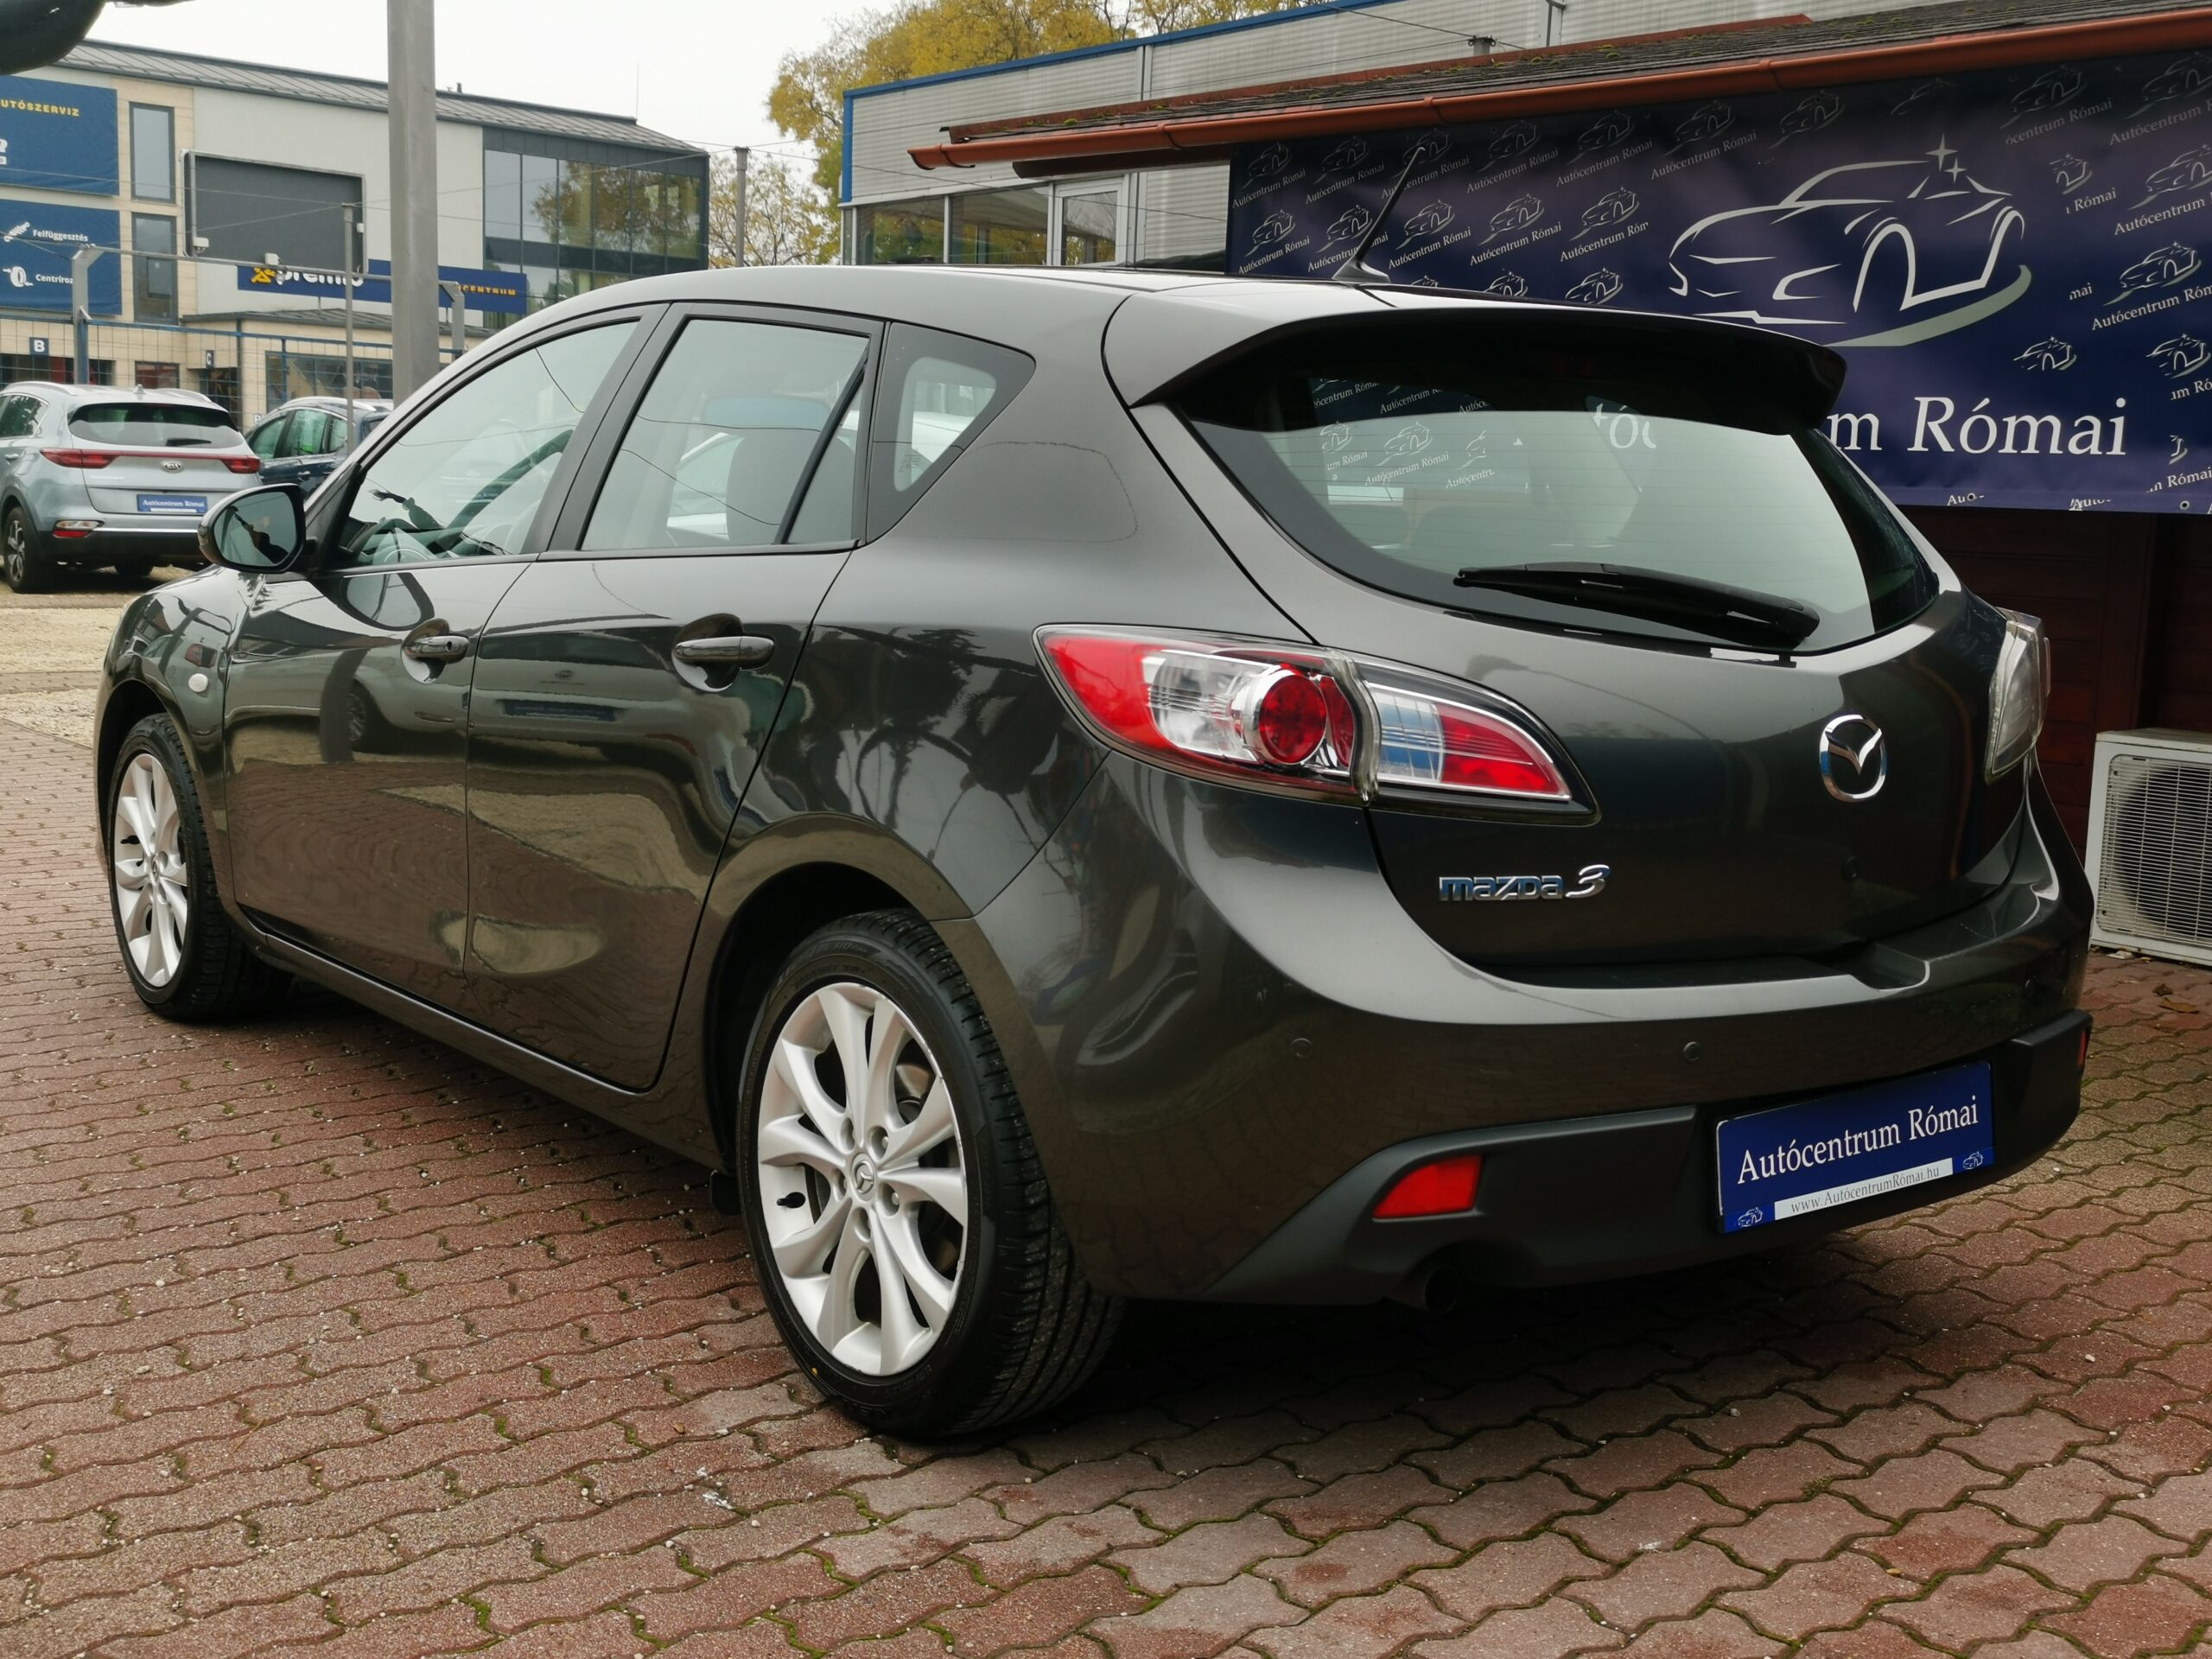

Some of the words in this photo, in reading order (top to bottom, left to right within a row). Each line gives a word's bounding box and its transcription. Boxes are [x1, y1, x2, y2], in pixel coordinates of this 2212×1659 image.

[2069, 98, 2113, 123] Római
[2110, 105, 2202, 145] Autócentrum
[1440, 155, 1469, 174] Római
[1467, 164, 1527, 194] Autócentrum
[1529, 147, 1559, 167] Római
[1557, 156, 1619, 187] Autócentrum
[1622, 138, 1653, 160] Római
[1651, 146, 1720, 180] Autócentrum
[1723, 130, 1757, 152] Római
[1232, 179, 1281, 208] Autócentrum
[1282, 168, 1306, 187] Római
[1306, 176, 1355, 204] Autócentrum
[1357, 165, 1384, 180] Római
[2074, 188, 2117, 212] Római
[33, 229, 88, 242] Felfüggesztés
[2114, 198, 2206, 235] Autócentrum
[1238, 245, 1283, 276] Autócentrum
[1285, 236, 1310, 254] Római
[1389, 241, 1440, 270] Autócentrum
[1443, 226, 1471, 246] Római
[1470, 237, 1529, 265] Autócentrum
[1532, 221, 1561, 241] Római
[1560, 232, 1625, 262] Autócentrum
[2092, 296, 2180, 331] Autócentrum
[34, 339, 45, 353] B
[1380, 391, 1430, 414] Autócentrum
[1907, 396, 2126, 456] Római
[1342, 450, 1368, 465] Római
[1364, 463, 1420, 486] Autócentrum
[1421, 451, 1450, 467] Római
[2167, 467, 2212, 487] Római
[1439, 874, 1563, 901] mazda
[1565, 863, 1611, 899] 3
[1737, 1122, 1901, 1185] Autócentrum
[1909, 1095, 1980, 1141] Római
[1791, 1165, 1940, 1214] www.AutócentrumRómai.hu
